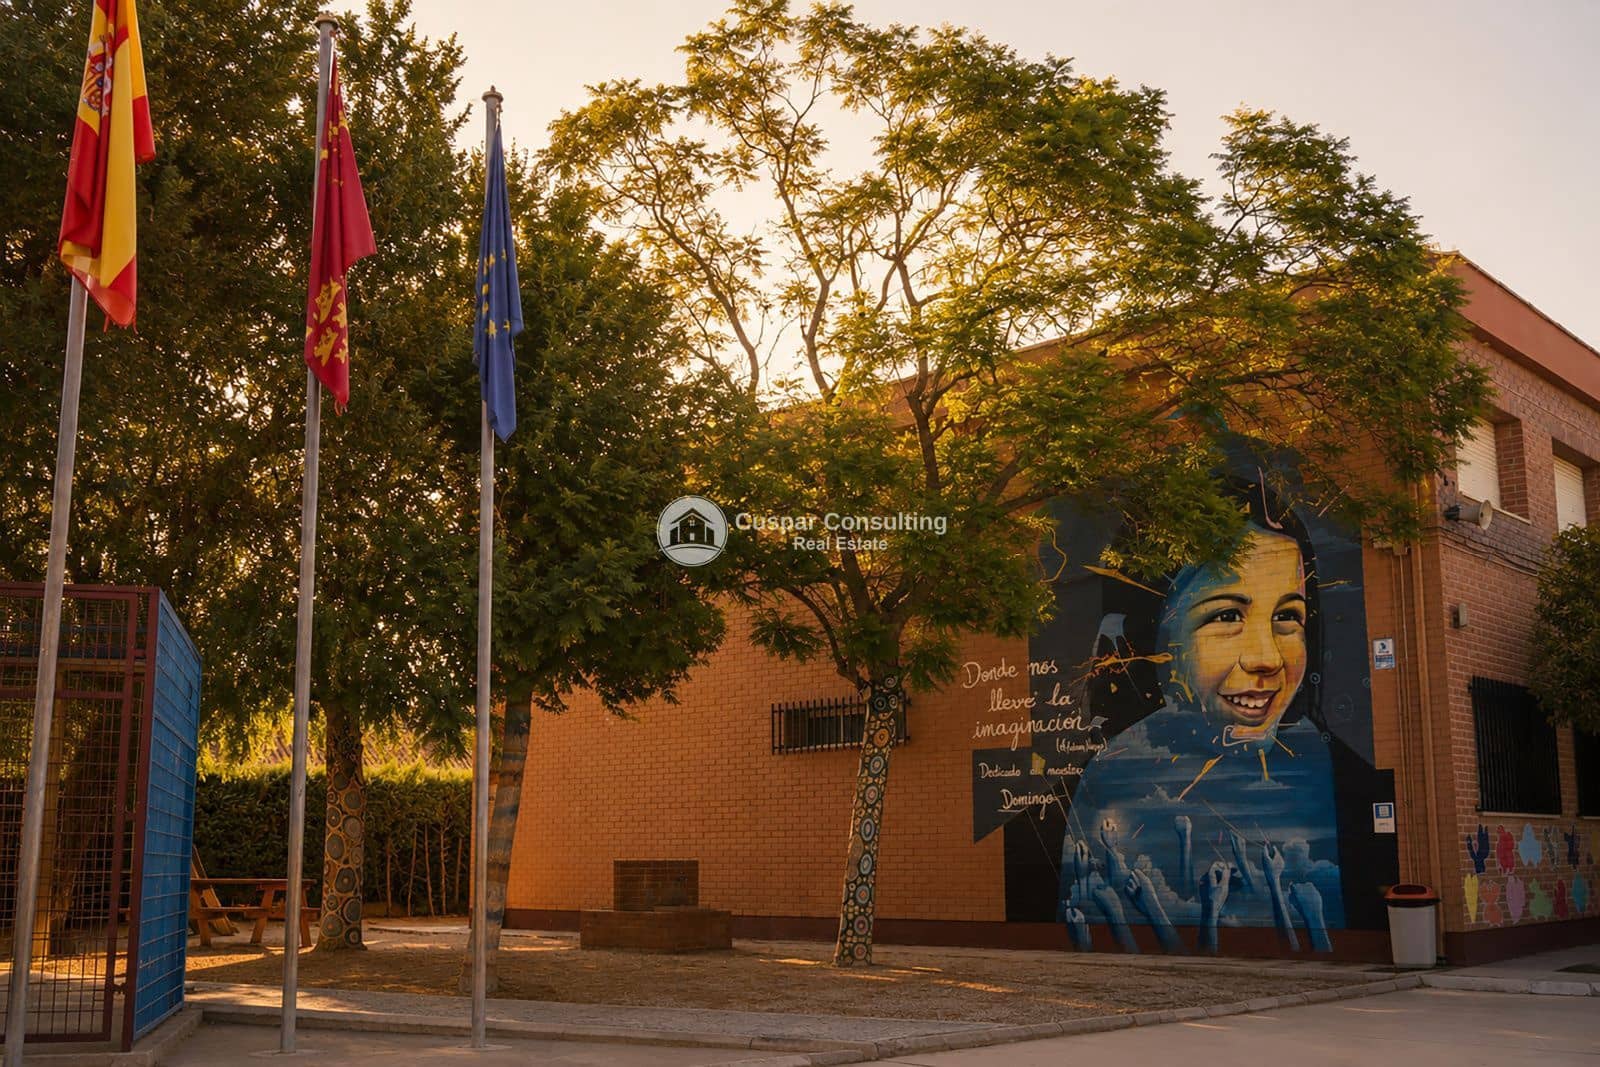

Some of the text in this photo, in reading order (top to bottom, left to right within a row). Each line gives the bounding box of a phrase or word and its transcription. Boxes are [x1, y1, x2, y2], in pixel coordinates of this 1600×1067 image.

[962, 657, 1059, 689] Donde nos
[1045, 682, 1074, 706] la
[978, 762, 1022, 779] Dedicado
[1047, 763, 1084, 776] maestro
[1000, 788, 1057, 821] Domingo
